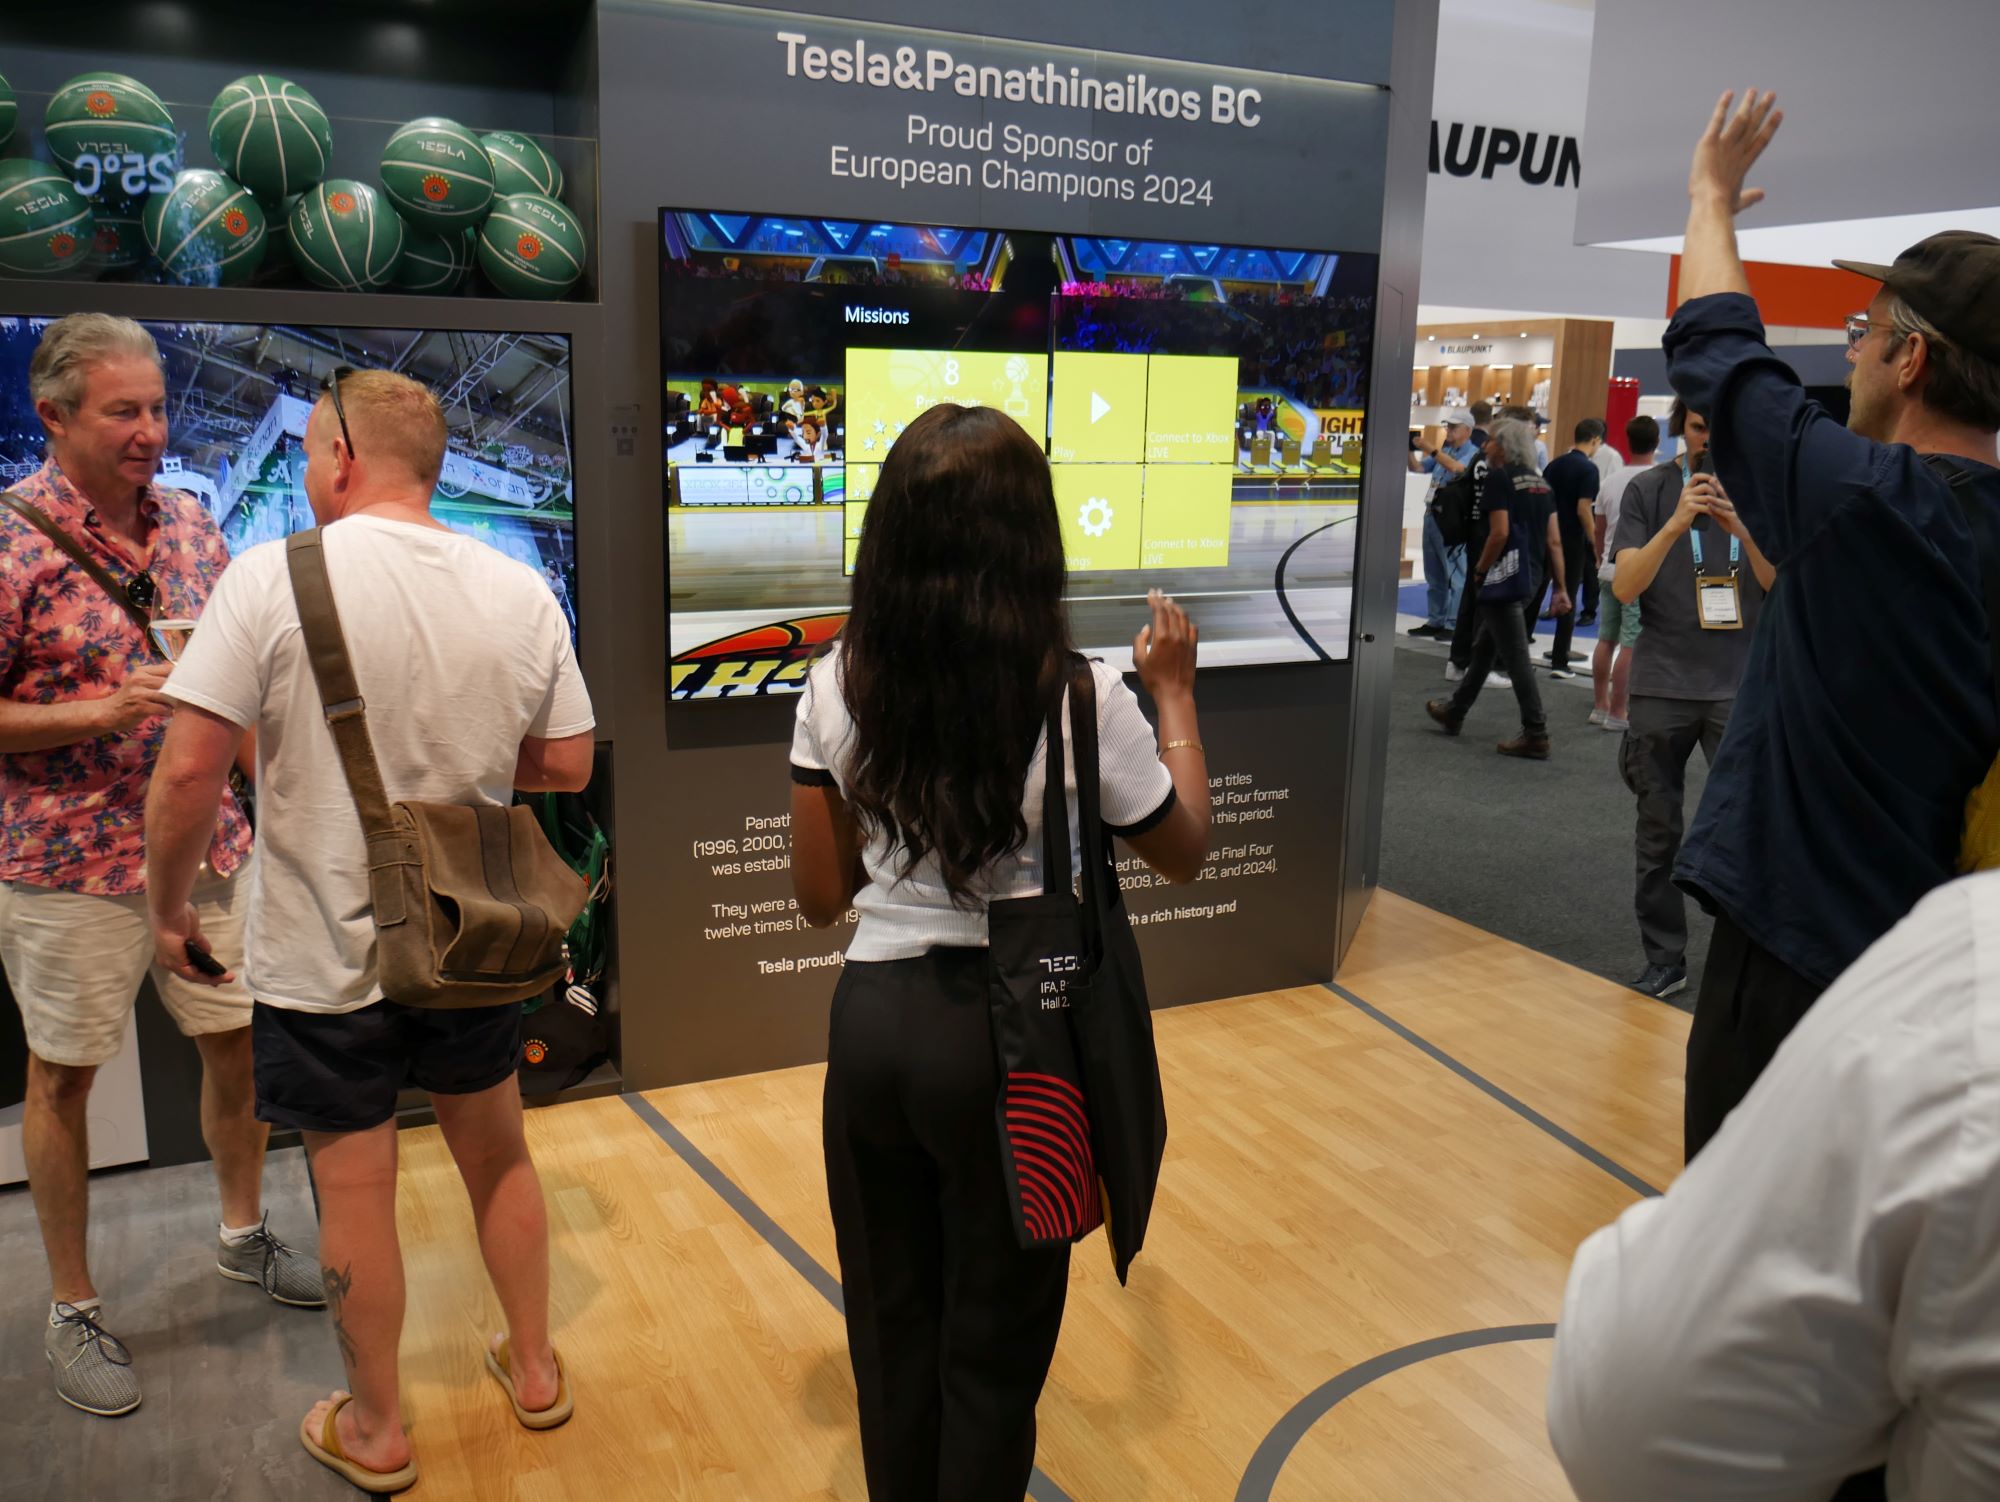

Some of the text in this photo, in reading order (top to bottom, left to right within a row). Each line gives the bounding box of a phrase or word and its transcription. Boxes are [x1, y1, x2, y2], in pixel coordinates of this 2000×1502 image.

[776, 31, 1262, 127] Tesla&Panathinaikos BC
[908, 114, 1153, 166] Proud Sponsor of
[416, 140, 466, 161] TESLA
[831, 145, 1213, 207] European Champions 2024
[15, 192, 70, 216] TESLA
[298, 196, 315, 241] TESL
[524, 201, 567, 232] TESLA
[845, 306, 910, 325] Missions
[1447, 344, 1493, 354] BLAUPUNKT
[944, 359, 960, 386] 8
[1149, 431, 1229, 444] Connect to Xbox
[1053, 447, 1076, 461] Play
[1148, 447, 1169, 459] LIVE
[1143, 553, 1164, 565] LIVE
[1225, 772, 1252, 787] titles
[1210, 788, 1289, 806] nal Four format
[745, 813, 792, 831] Panath
[1216, 811, 1237, 824] this
[1239, 806, 1275, 825] period.
[693, 839, 739, 858] (1996,
[742, 834, 786, 852] 2000,
[1221, 844, 1247, 860] Final
[1249, 843, 1274, 856] Four
[712, 855, 791, 876] was establi
[1220, 862, 1241, 877] and
[1243, 858, 1278, 874] 2024).
[712, 903, 748, 919] They
[751, 899, 785, 914] were
[1141, 914, 1149, 924] a
[1150, 908, 1172, 923] rich
[1174, 904, 1214, 919] history
[1215, 899, 1237, 915] and
[704, 922, 751, 940] twelve
[754, 919, 793, 934] times
[758, 956, 794, 974] Tesla
[1039, 956, 1080, 973] TES
[1040, 981, 1059, 994] IFA,
[1041, 996, 1060, 1010] Hall
